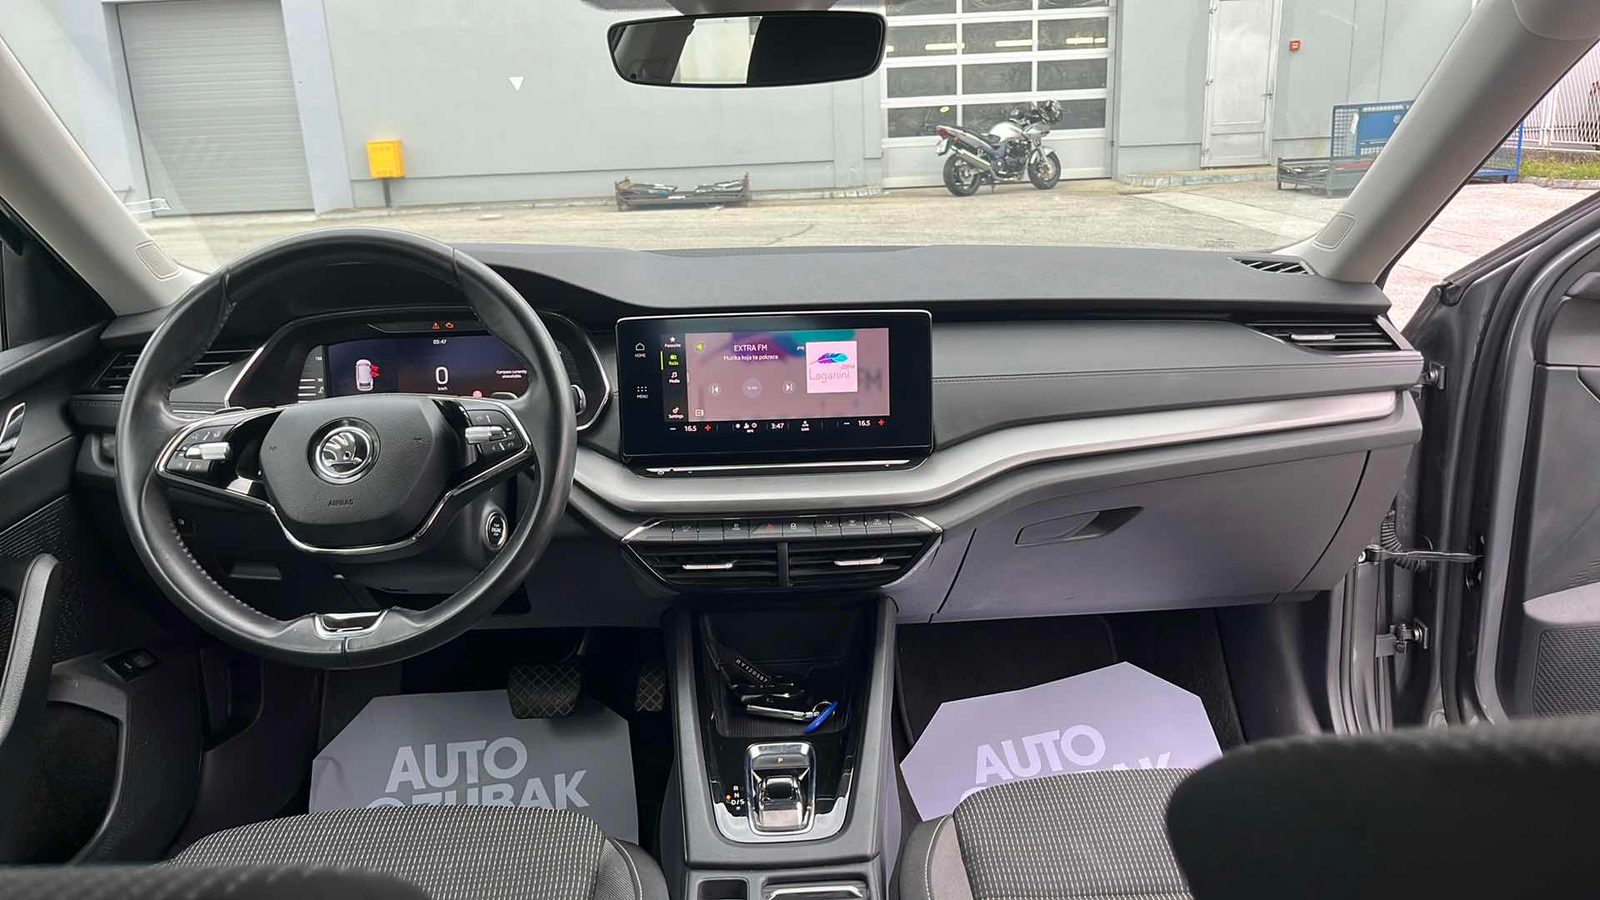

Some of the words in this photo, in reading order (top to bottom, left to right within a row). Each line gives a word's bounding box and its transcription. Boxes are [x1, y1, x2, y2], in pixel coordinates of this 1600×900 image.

[733, 344, 757, 352] EXTRA
[435, 366, 449, 385] 0
[771, 422, 785, 430] 3:47
[975, 724, 1106, 783] AUTO
[385, 737, 528, 793] AUTO
